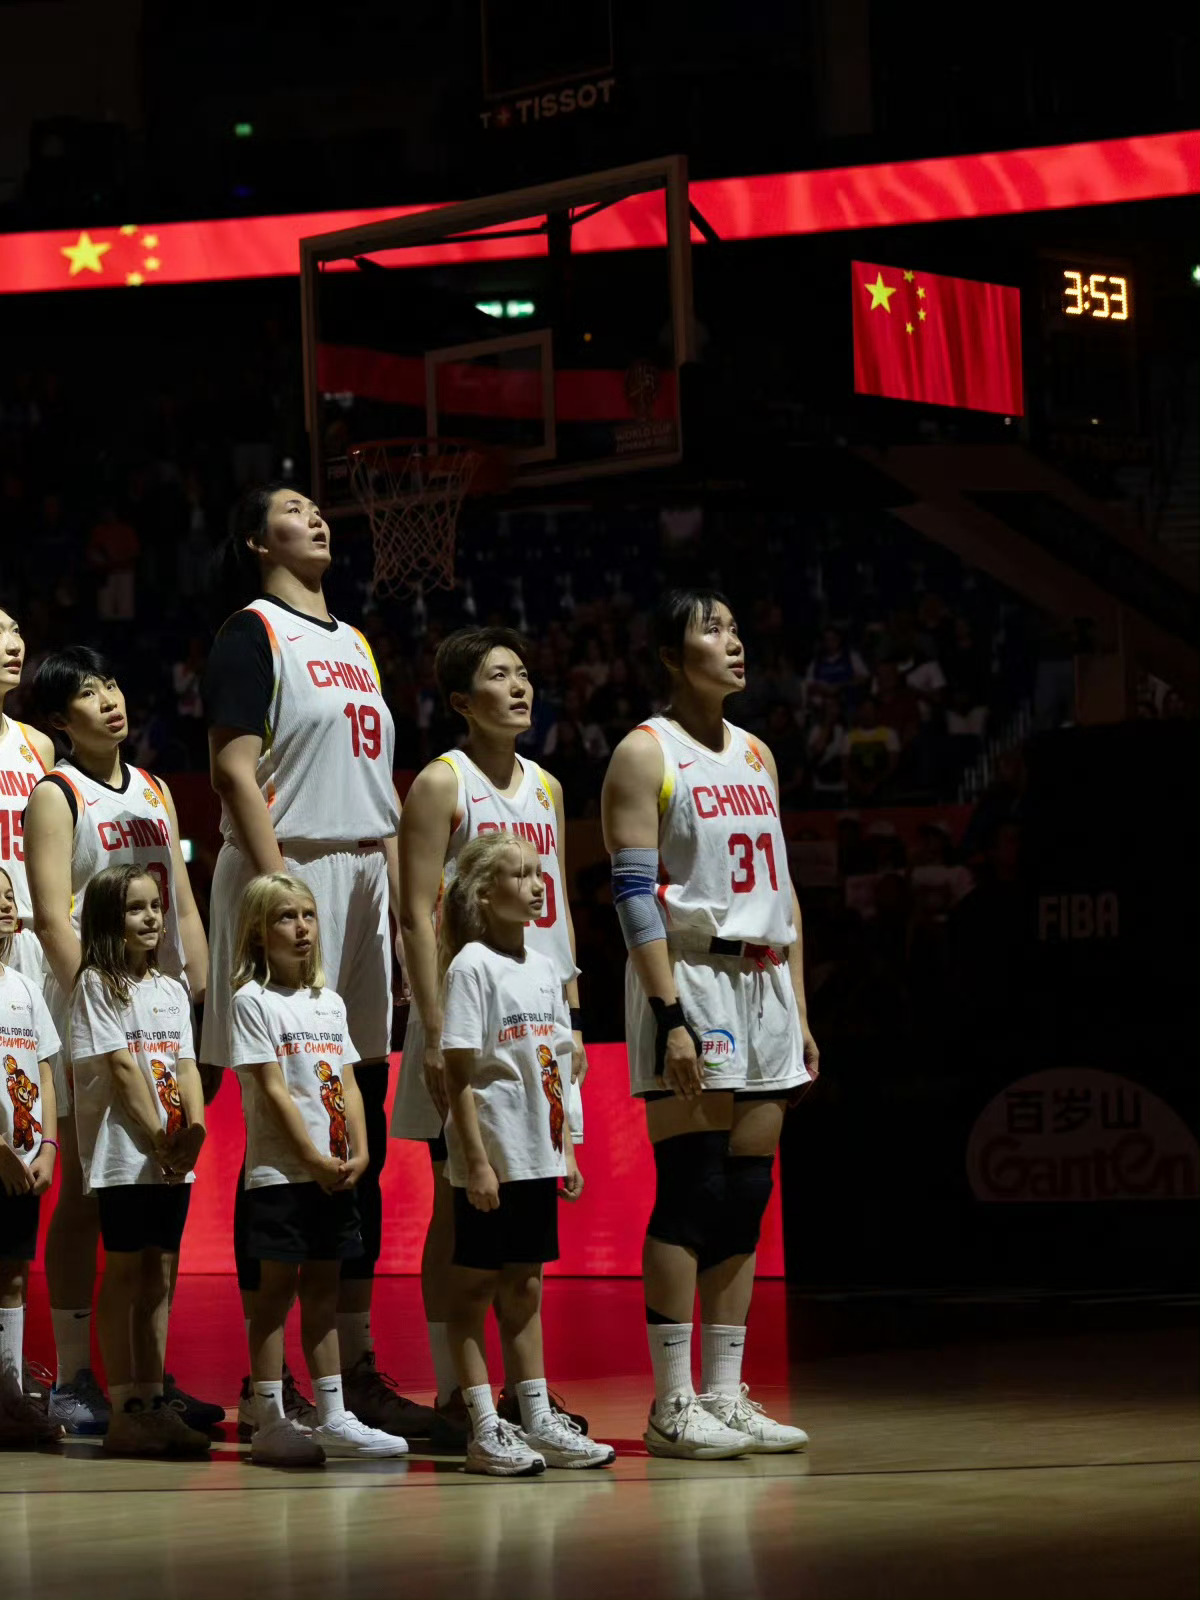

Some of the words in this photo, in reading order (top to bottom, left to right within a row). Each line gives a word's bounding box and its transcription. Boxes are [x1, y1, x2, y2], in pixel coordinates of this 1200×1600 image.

[515, 79, 616, 124] TISSOT
[1063, 270, 1129, 320] 3:53
[307, 660, 381, 697] CHINA
[343, 702, 382, 761] 19
[692, 784, 778, 819] CHINA
[97, 818, 171, 851] CHINA
[728, 832, 779, 894] 31
[1037, 890, 1120, 942] FIBA
[11, 1027, 22, 1036] FOR
[23, 1028, 34, 1037] GOO
[152, 1030, 167, 1040] FOR
[1006, 1088, 1141, 1135] 百岁山
